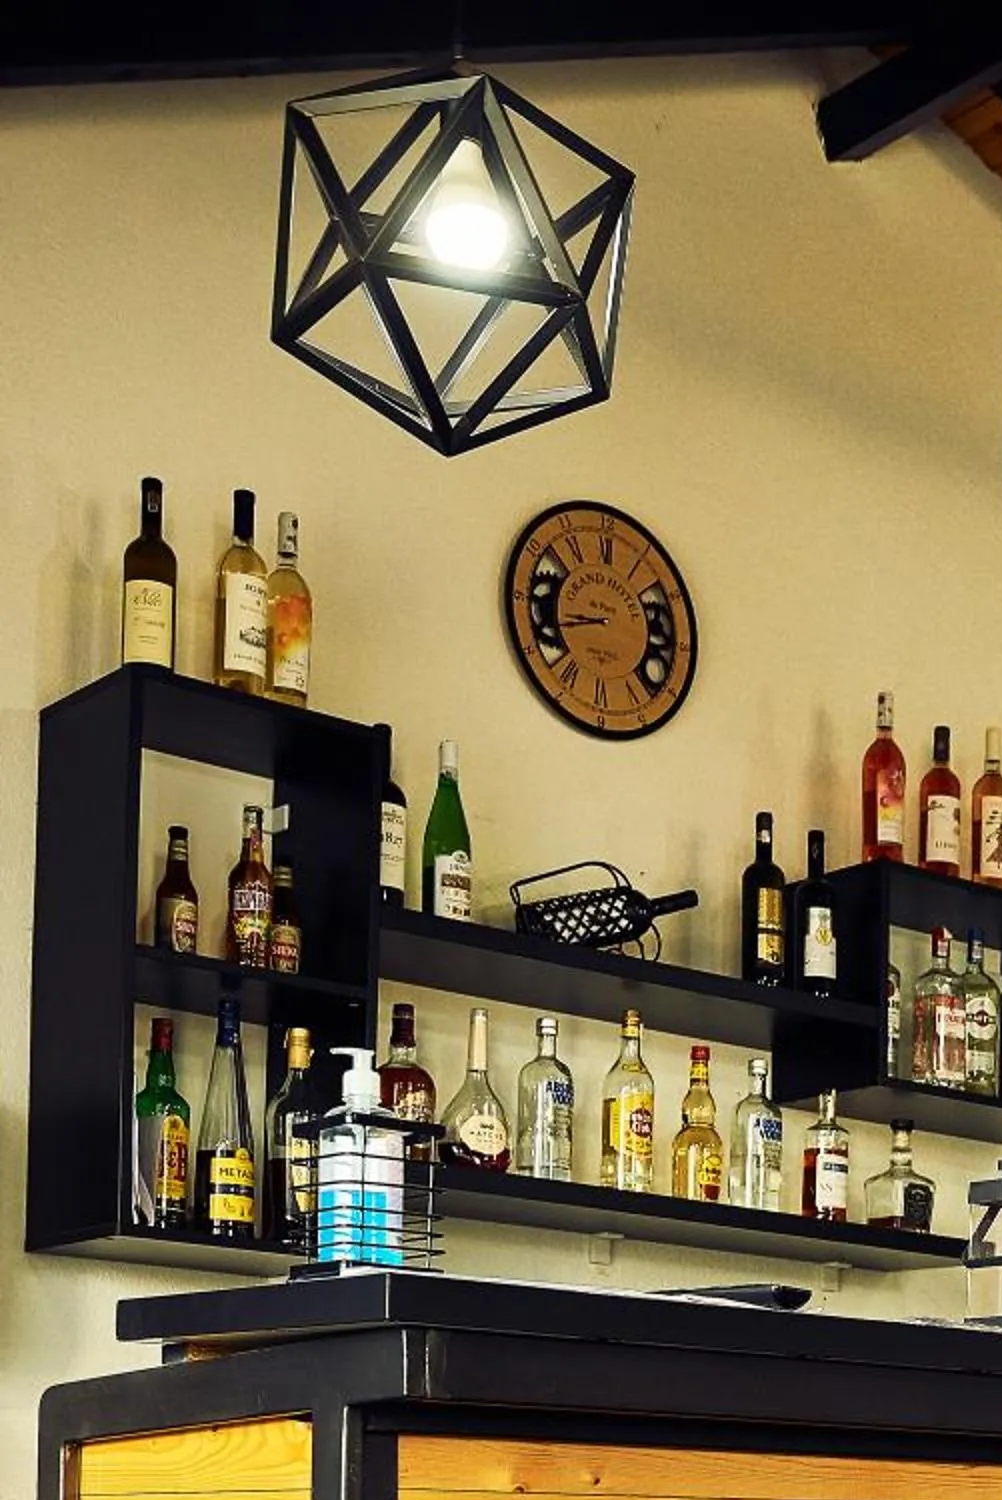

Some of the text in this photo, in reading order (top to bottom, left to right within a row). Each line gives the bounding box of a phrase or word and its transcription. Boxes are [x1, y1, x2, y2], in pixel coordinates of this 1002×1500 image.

[600, 516, 616, 531] 12
[526, 538, 541, 556] 10
[566, 572, 640, 622] GRAND HOTEL
